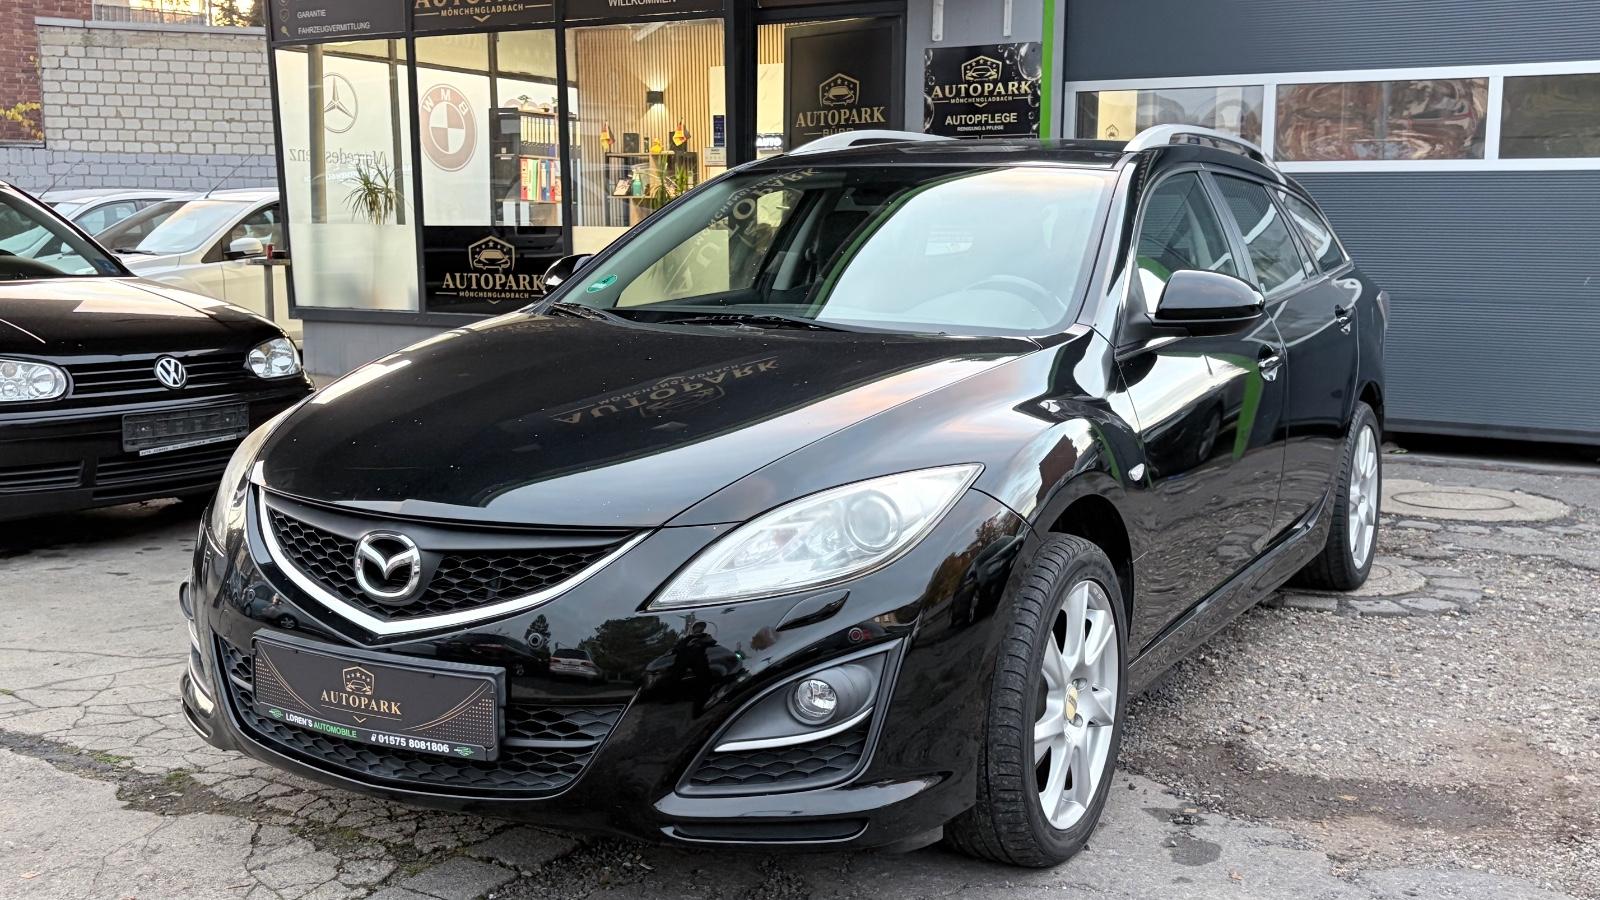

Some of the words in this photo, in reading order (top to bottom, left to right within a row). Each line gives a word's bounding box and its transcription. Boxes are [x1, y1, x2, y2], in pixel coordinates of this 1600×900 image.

[296, 9, 327, 19] GARANTIE
[440, 3, 524, 17] MÖNCHENGLADBACH
[297, 21, 371, 35] FAHRZEUGVERMITTLUNG
[931, 81, 1032, 98] AUTOPARK
[950, 96, 1013, 104] MÖNCHENGLADBACH
[795, 106, 886, 128] AUTOPARK
[945, 112, 1018, 126] AUTOPFLEGE
[442, 272, 545, 291] AUTOPARK
[459, 289, 529, 299] MÖNCHENGLADBACH
[320, 689, 402, 715] AUTOPARK
[313, 721, 357, 738] AUTOMOBILE
[378, 734, 406, 747] 01575
[408, 739, 450, 753] 8081806
